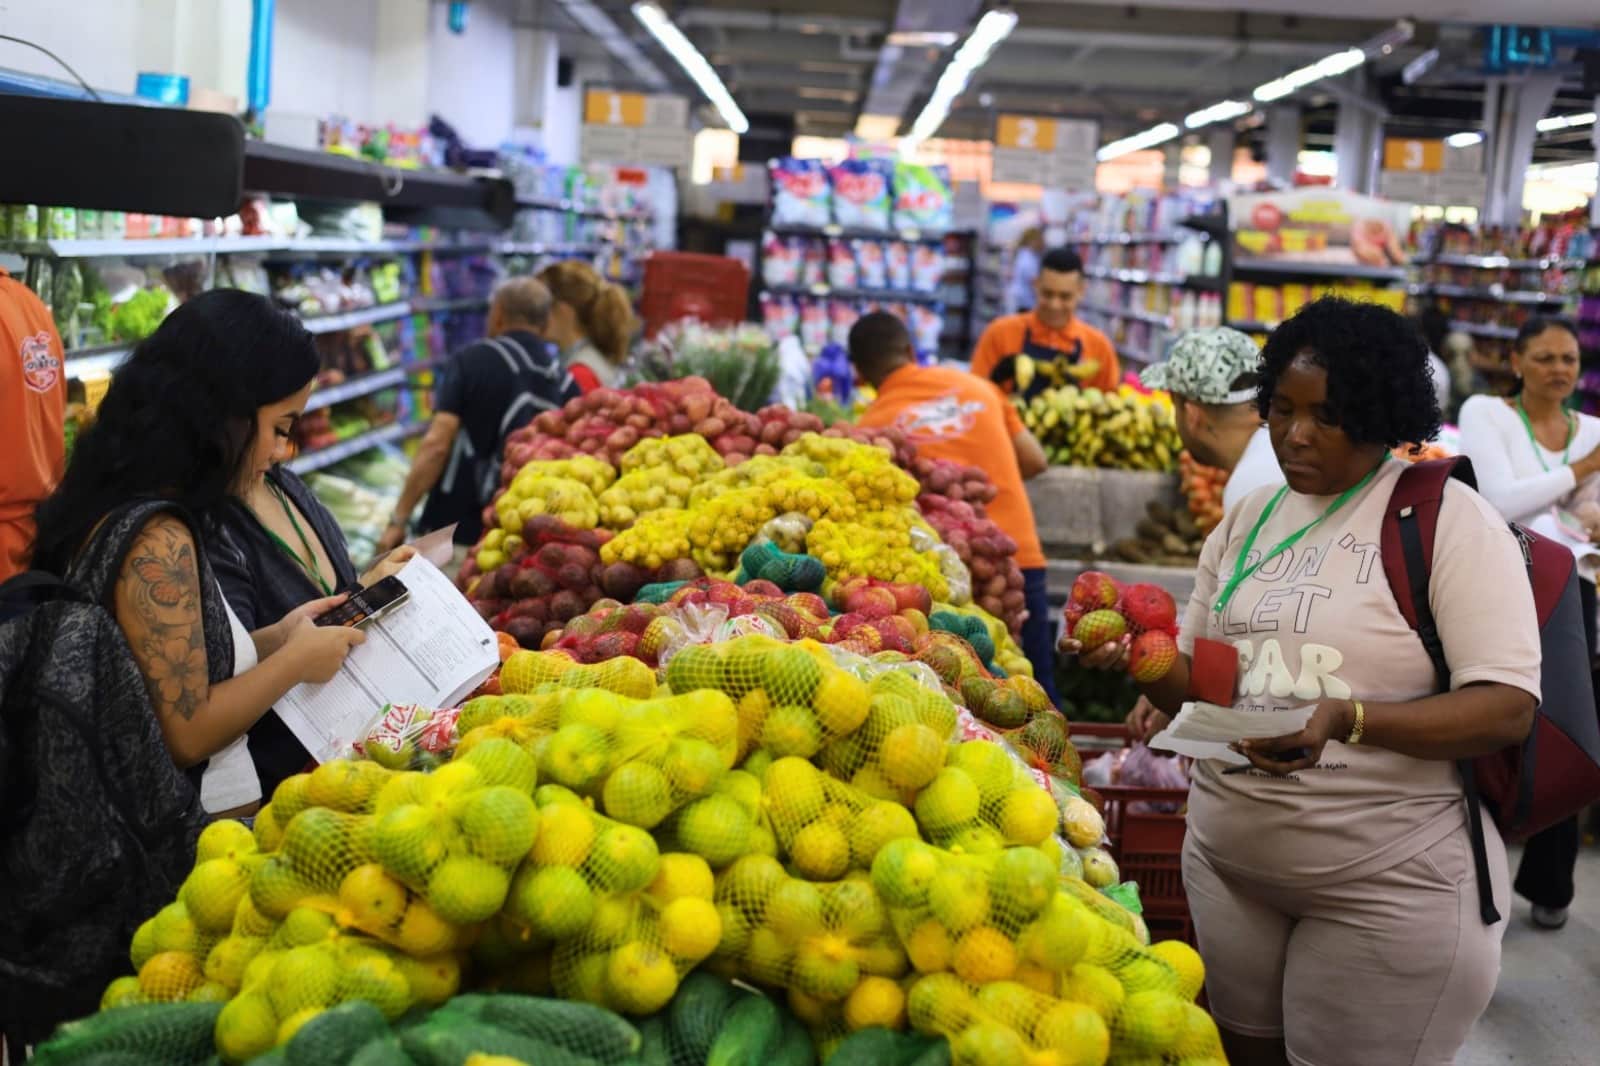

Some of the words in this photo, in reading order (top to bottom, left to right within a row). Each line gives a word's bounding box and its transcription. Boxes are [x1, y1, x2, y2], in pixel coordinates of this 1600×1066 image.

[608, 94, 624, 125] 1
[1016, 117, 1037, 148] 2
[1403, 139, 1424, 168] 3
[1222, 583, 1333, 636] LET
